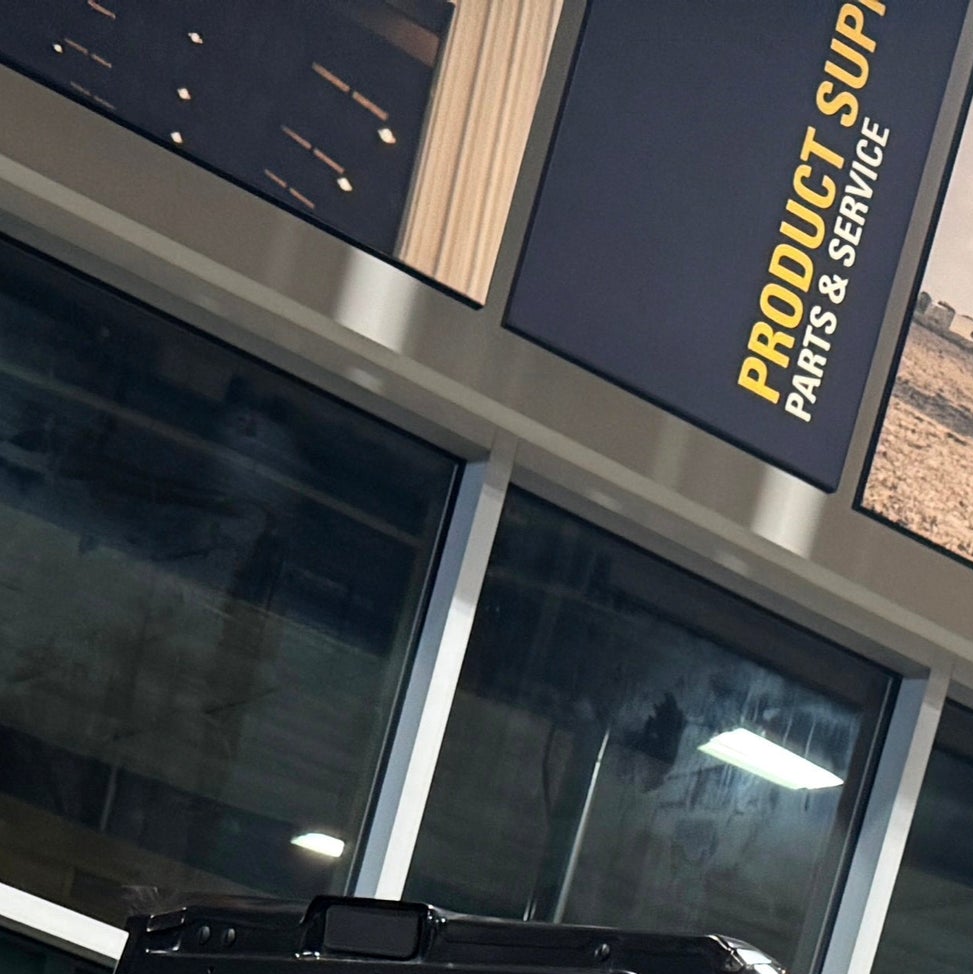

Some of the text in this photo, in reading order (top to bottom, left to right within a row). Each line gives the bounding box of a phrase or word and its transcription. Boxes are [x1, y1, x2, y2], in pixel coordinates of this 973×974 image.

[738, 125, 845, 405] PRODUCT
[784, 116, 890, 422] PARTS & SERVICE
